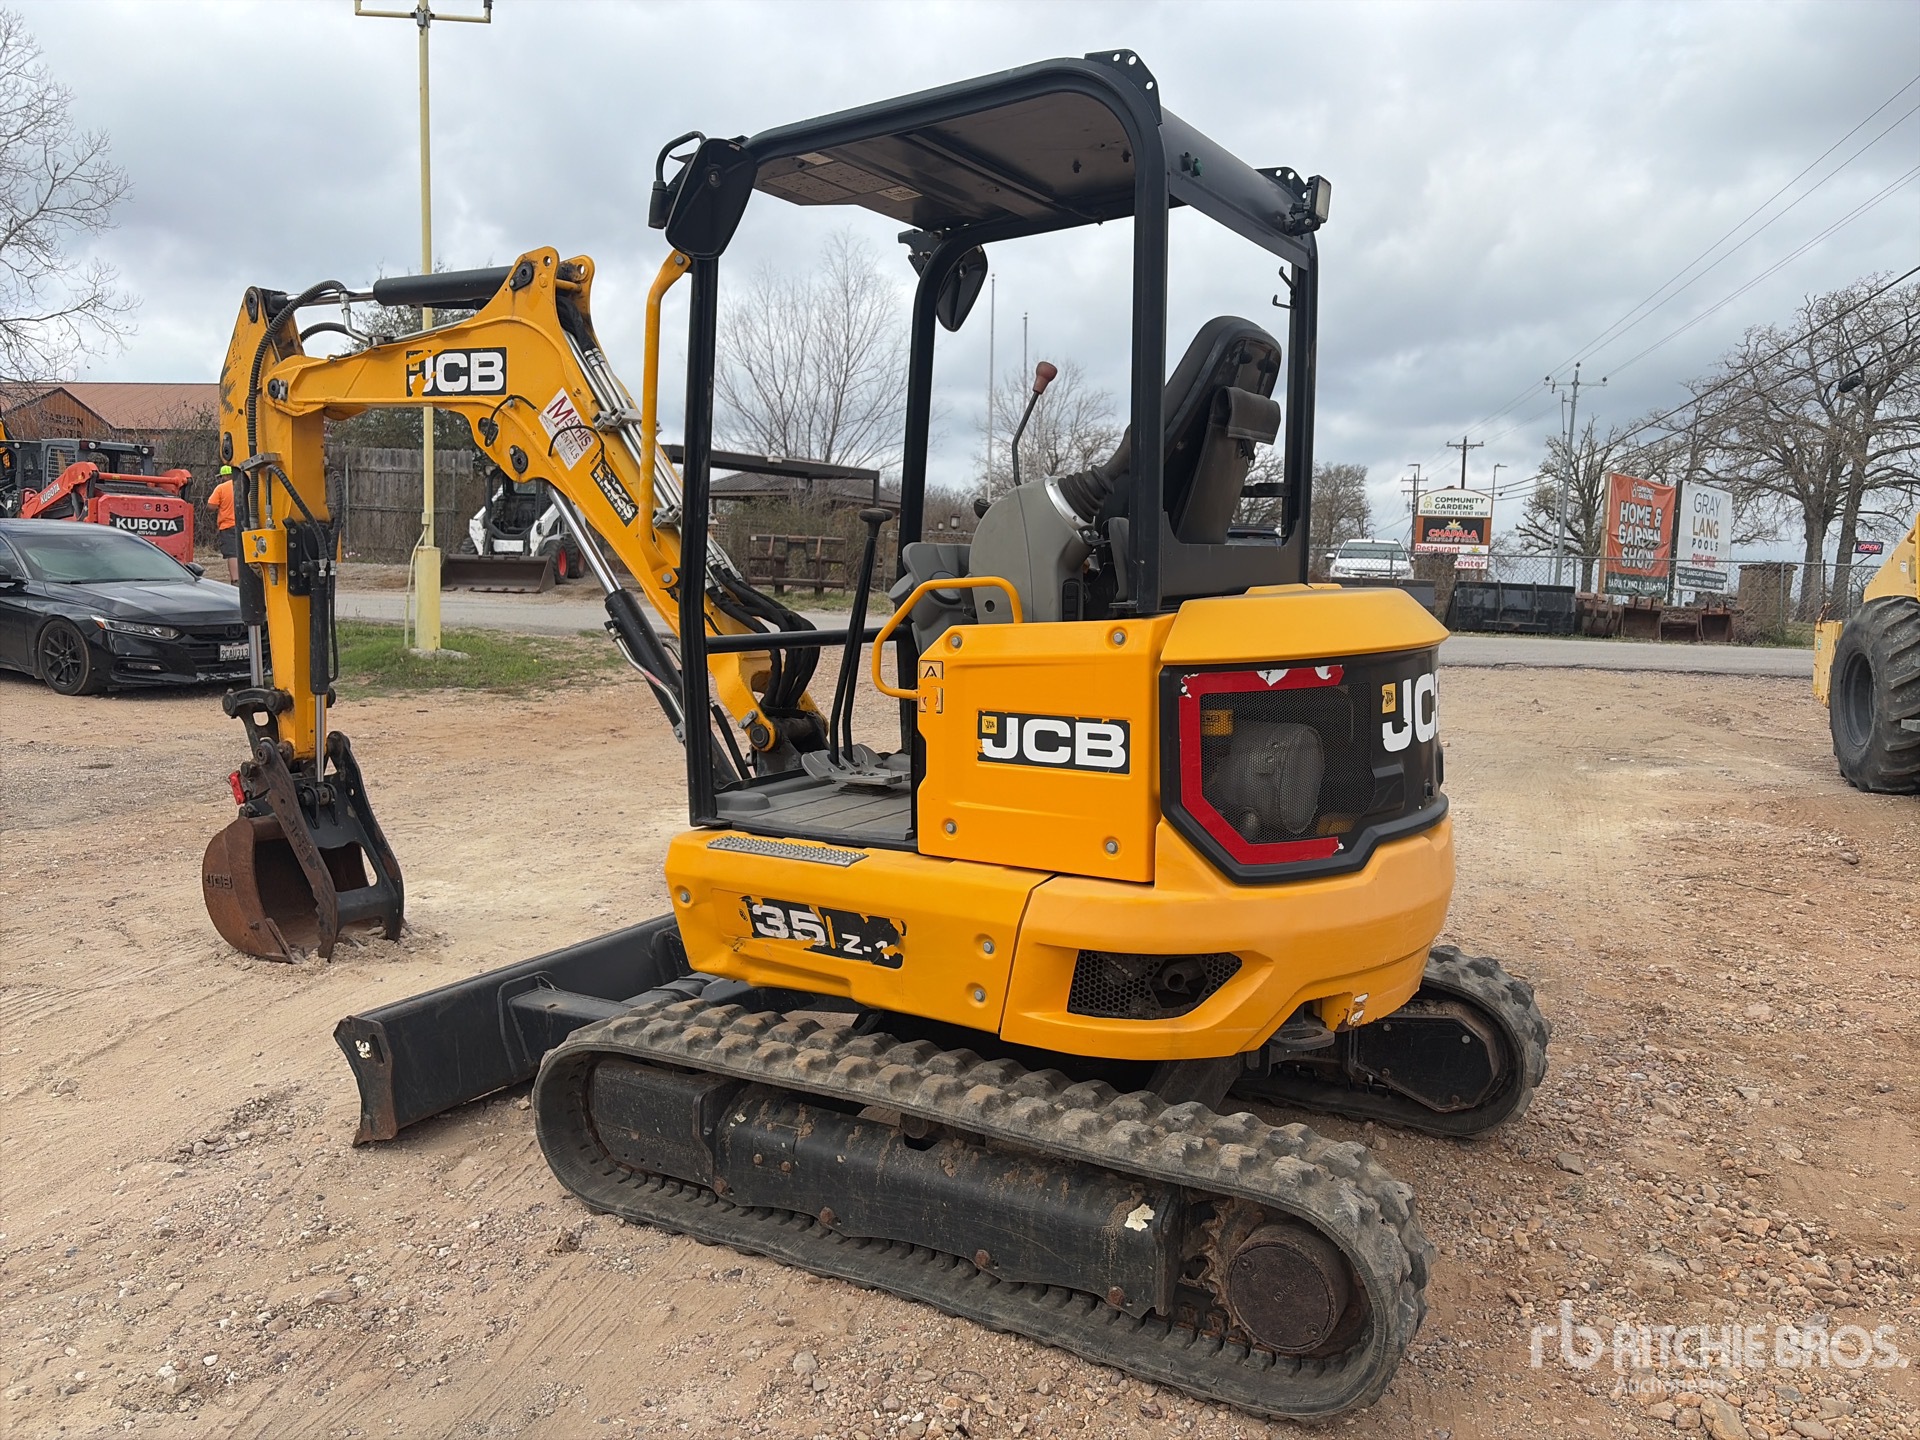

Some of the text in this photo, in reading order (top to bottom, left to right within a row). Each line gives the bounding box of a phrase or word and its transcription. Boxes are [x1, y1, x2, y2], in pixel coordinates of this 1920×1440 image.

[409, 352, 504, 392] JCB
[546, 395, 592, 448] MATHIS
[40, 482, 60, 504] KUBOTA
[1693, 492, 1722, 517] GRAY
[155, 503, 170, 512] 83
[1620, 500, 1662, 528] HOME &
[115, 518, 178, 531] KUBOTA
[1428, 529, 1478, 538] CHAPALA
[1618, 523, 1661, 547] GARDEN
[1692, 515, 1719, 540] LANG
[1416, 544, 1461, 554] Restaurant
[1692, 538, 1718, 551] POOLS
[1455, 560, 1485, 568] enter
[1621, 546, 1654, 570] SHOW
[981, 717, 1127, 769] JCB
[752, 904, 826, 946] 35
